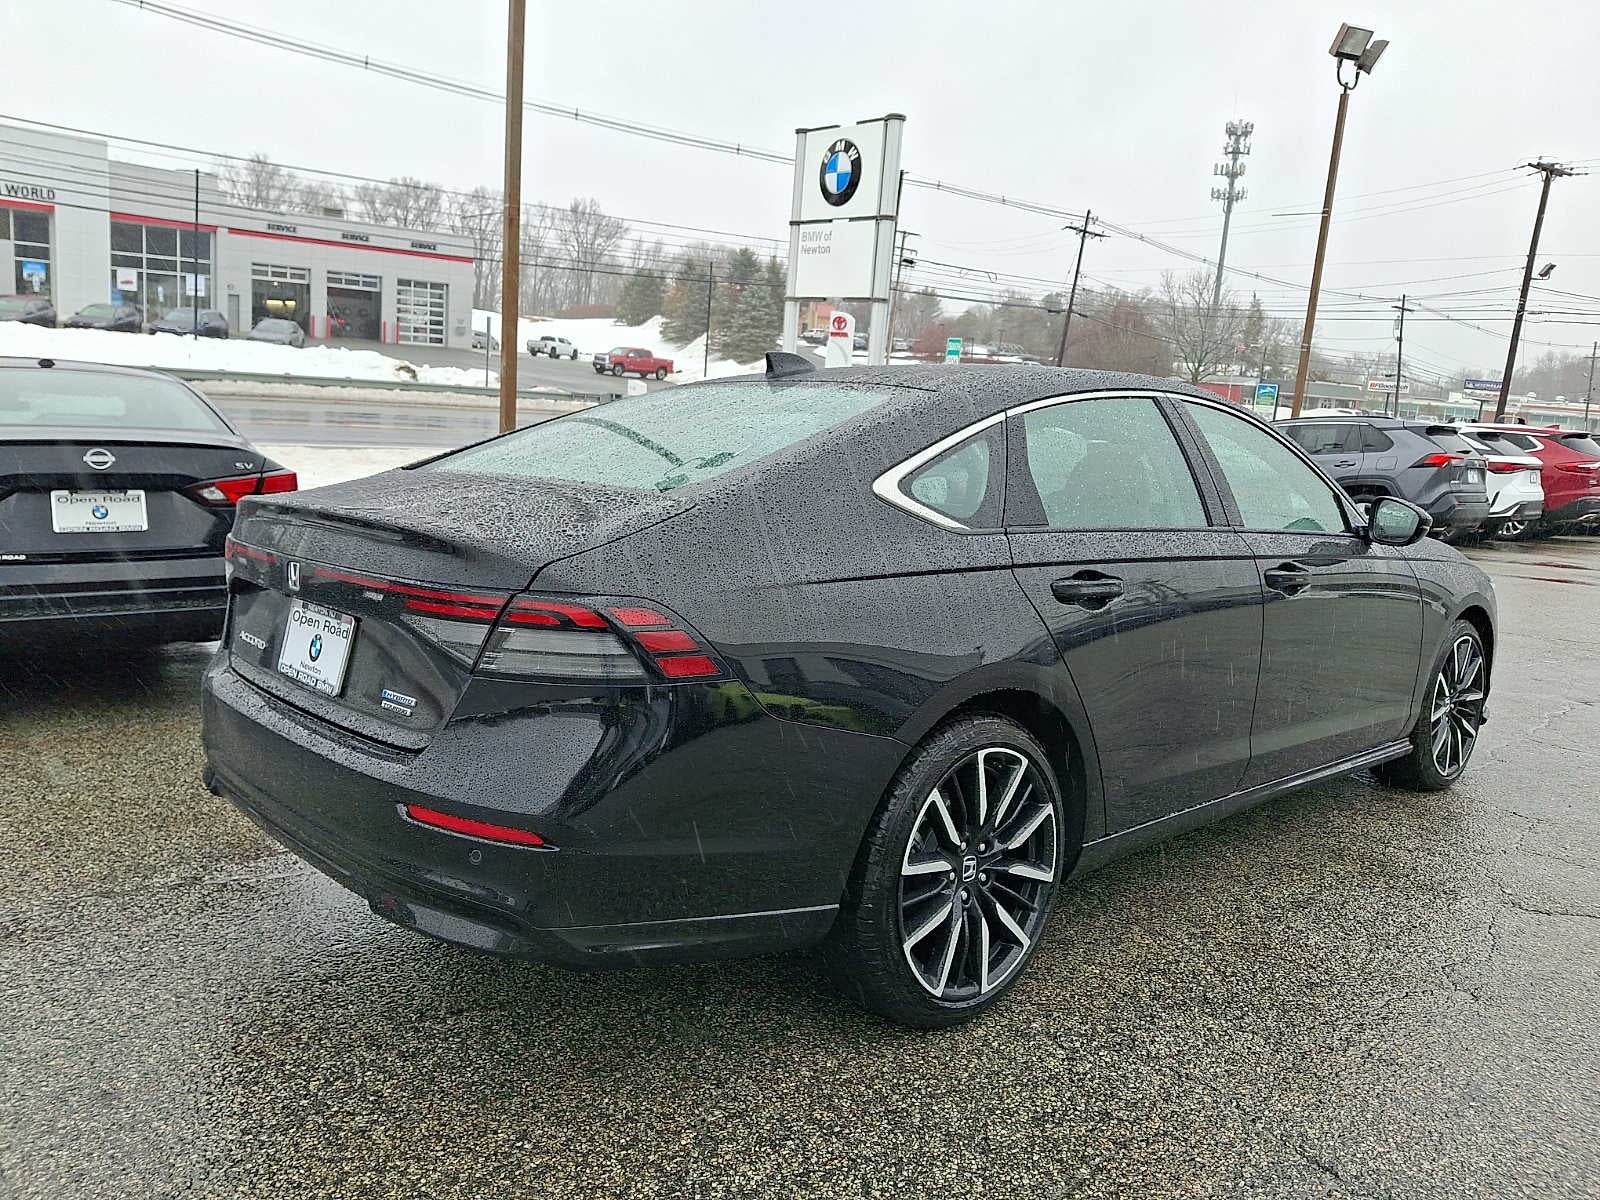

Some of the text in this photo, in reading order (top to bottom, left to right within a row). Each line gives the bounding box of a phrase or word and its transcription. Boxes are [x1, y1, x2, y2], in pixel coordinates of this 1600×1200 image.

[823, 140, 859, 164] BMW
[5, 183, 56, 200] WORLD
[267, 223, 297, 233] SERVICE
[341, 232, 369, 242] SERVICE
[802, 231, 833, 242] BMW of
[410, 241, 437, 250] SERVICE
[801, 245, 831, 255] Newton
[235, 462, 254, 470] SV
[57, 495, 140, 505] Open Road
[293, 609, 350, 640] Open Road
[300, 660, 322, 676] Newton
[280, 665, 335, 695] OPEN ROAD BMW
[386, 692, 414, 704] HYBRID
